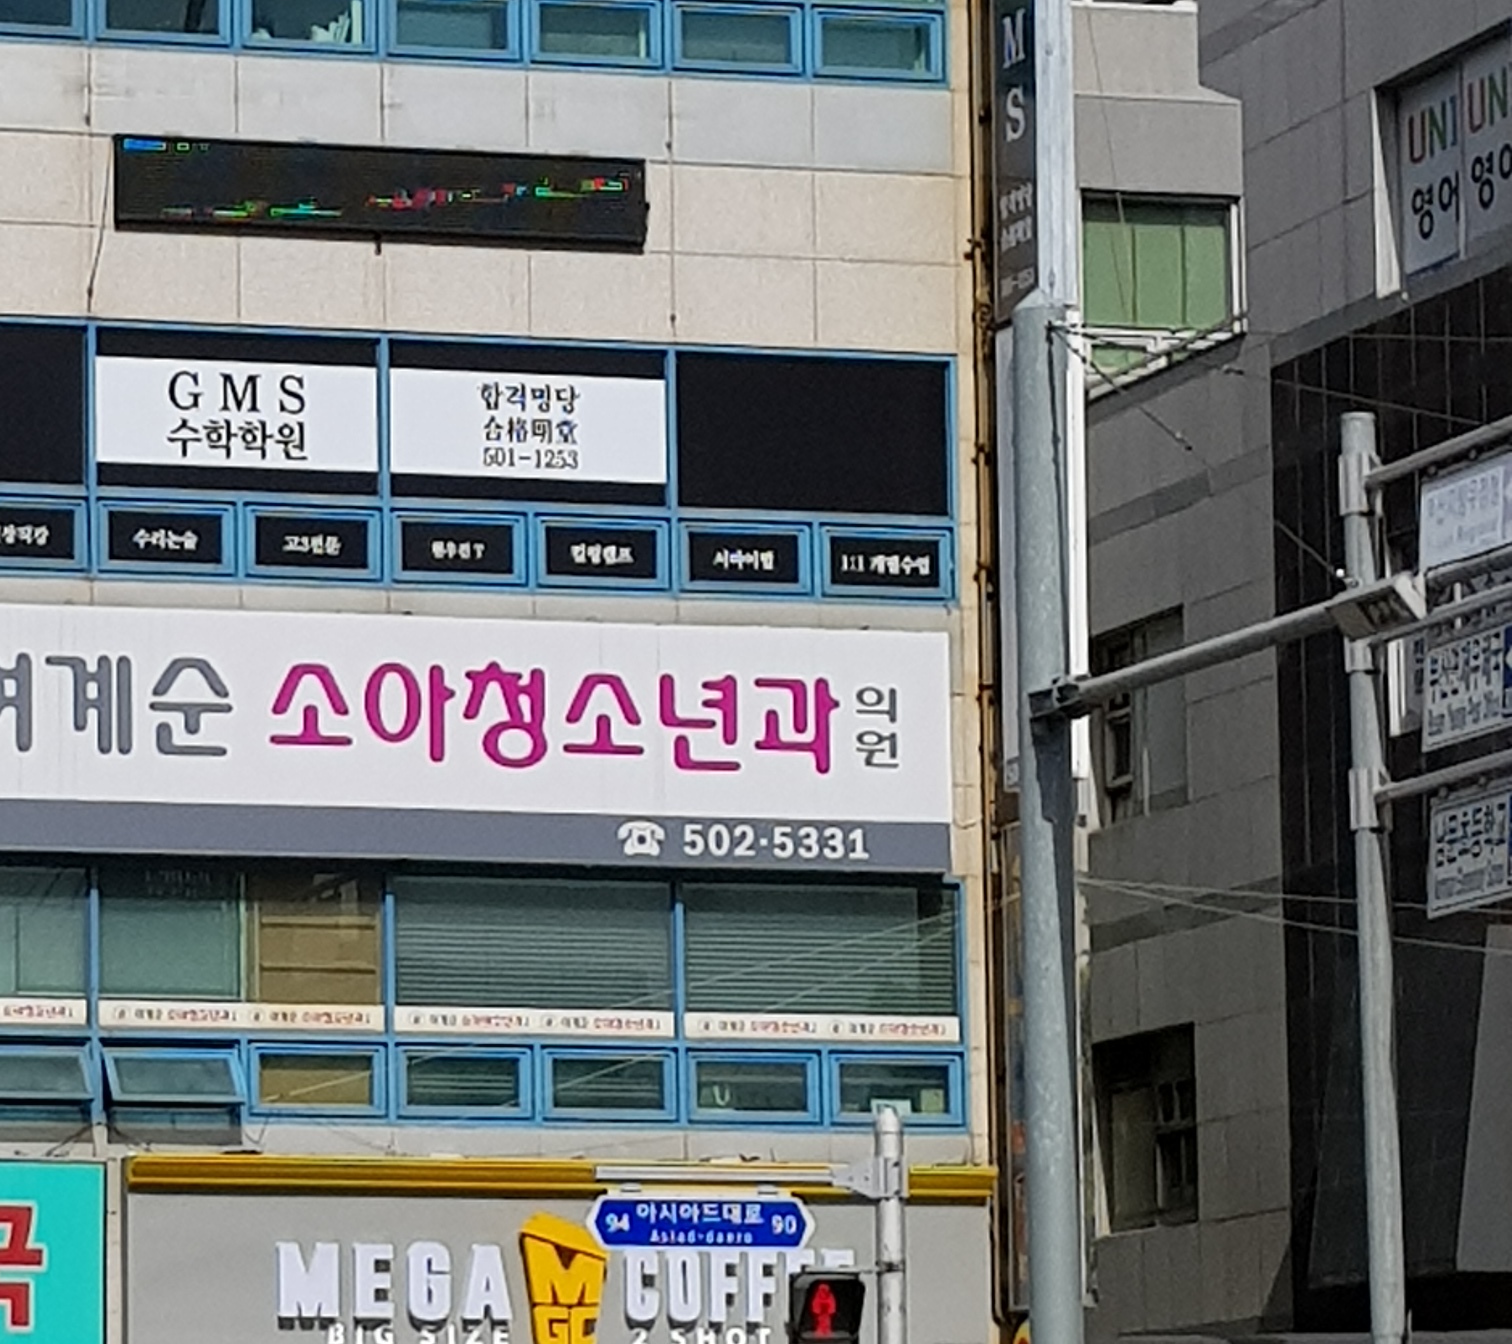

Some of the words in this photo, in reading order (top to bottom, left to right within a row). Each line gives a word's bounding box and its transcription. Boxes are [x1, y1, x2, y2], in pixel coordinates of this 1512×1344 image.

[1408, 94, 1458, 165] UNI
[1467, 64, 1512, 134] UN
[1411, 169, 1460, 240] 영어
[166, 418, 309, 461] 수학학원
[482, 446, 580, 470] 501-1253
[268, 660, 841, 775] 소아청소년과
[854, 685, 900, 769] 의원
[605, 1212, 631, 1233] 94
[635, 1202, 766, 1225] 아시아드대로
[771, 1214, 798, 1235] 90
[275, 1240, 513, 1323] MEGA
[624, 1248, 856, 1323] COFF
